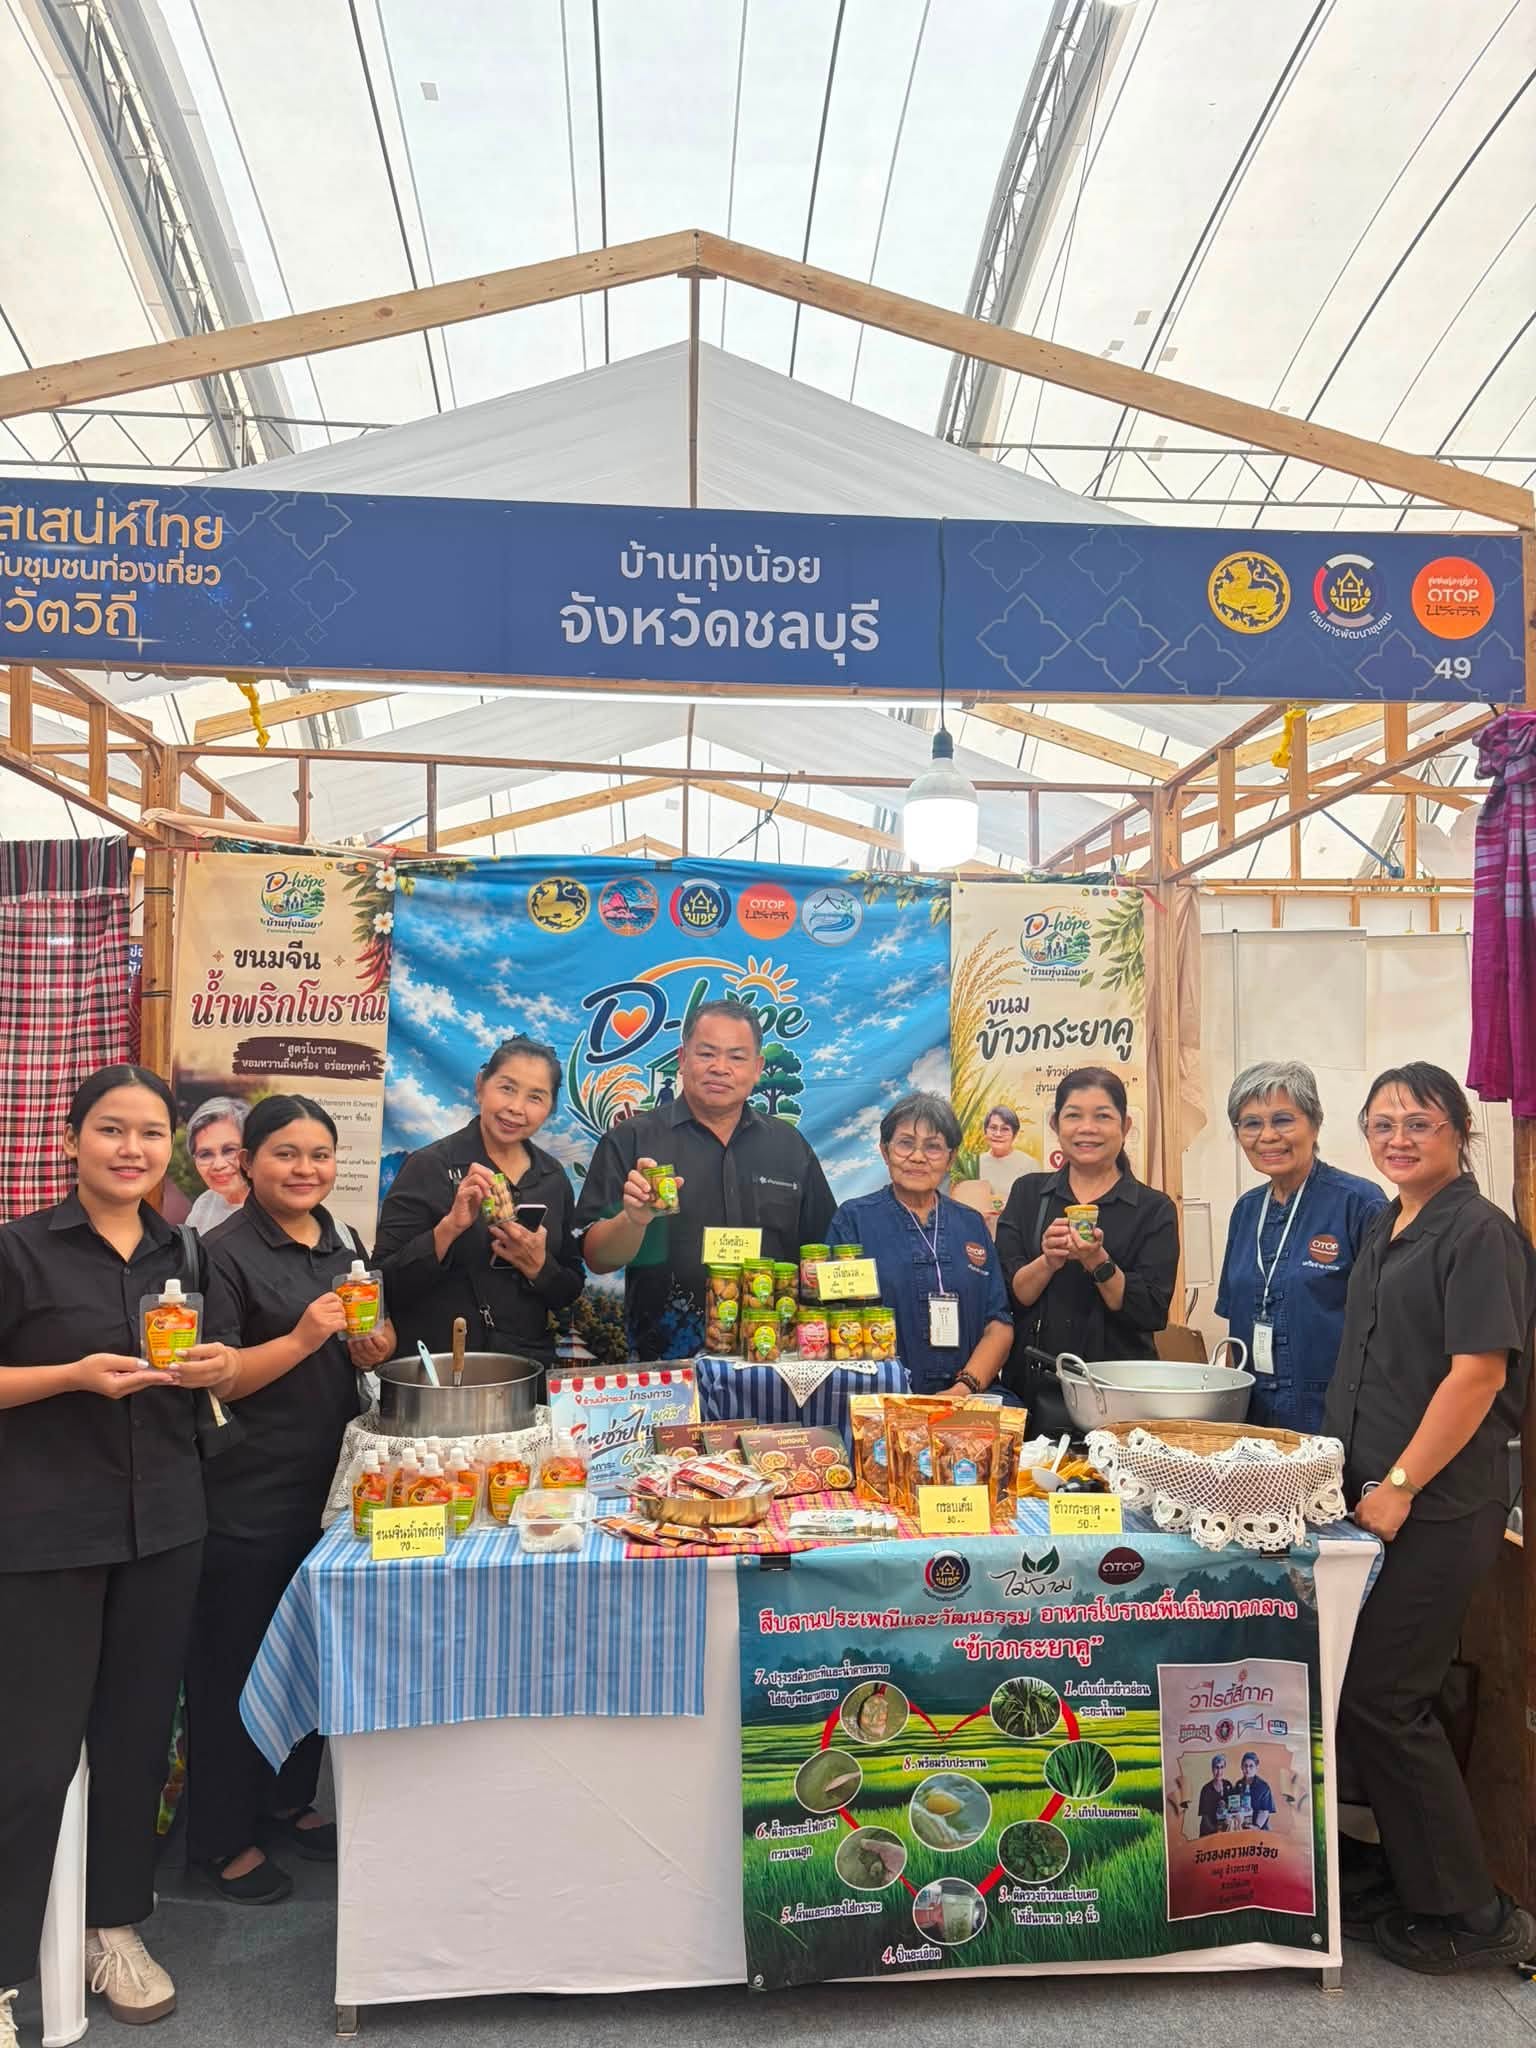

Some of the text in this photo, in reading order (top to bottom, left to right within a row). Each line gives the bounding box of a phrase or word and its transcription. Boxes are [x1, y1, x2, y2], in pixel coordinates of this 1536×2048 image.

[619, 540, 821, 591] บ้านทุ่งน้อย
[1427, 588, 1480, 603] OTOP
[559, 591, 880, 666] จังหวัดชลบุรี
[1308, 610, 1393, 640] กรมการพัฒนาชุมชน
[1434, 656, 1472, 680] 49
[750, 899, 785, 910] OTOP
[233, 940, 321, 970] ขนมจีน
[191, 969, 388, 1029] น้ำพริกโบราณ
[987, 996, 1030, 1016] ขนม
[975, 1016, 1134, 1062] ข้าวกระยาคู
[1312, 1240, 1338, 1251] OTOP
[1102, 1561, 1142, 1572] OTOP
[759, 1588, 1298, 1634] สืบสานประเพณีและวัฒนธรรม อาหารโบราณพื้นถิ่นภาคกลาง
